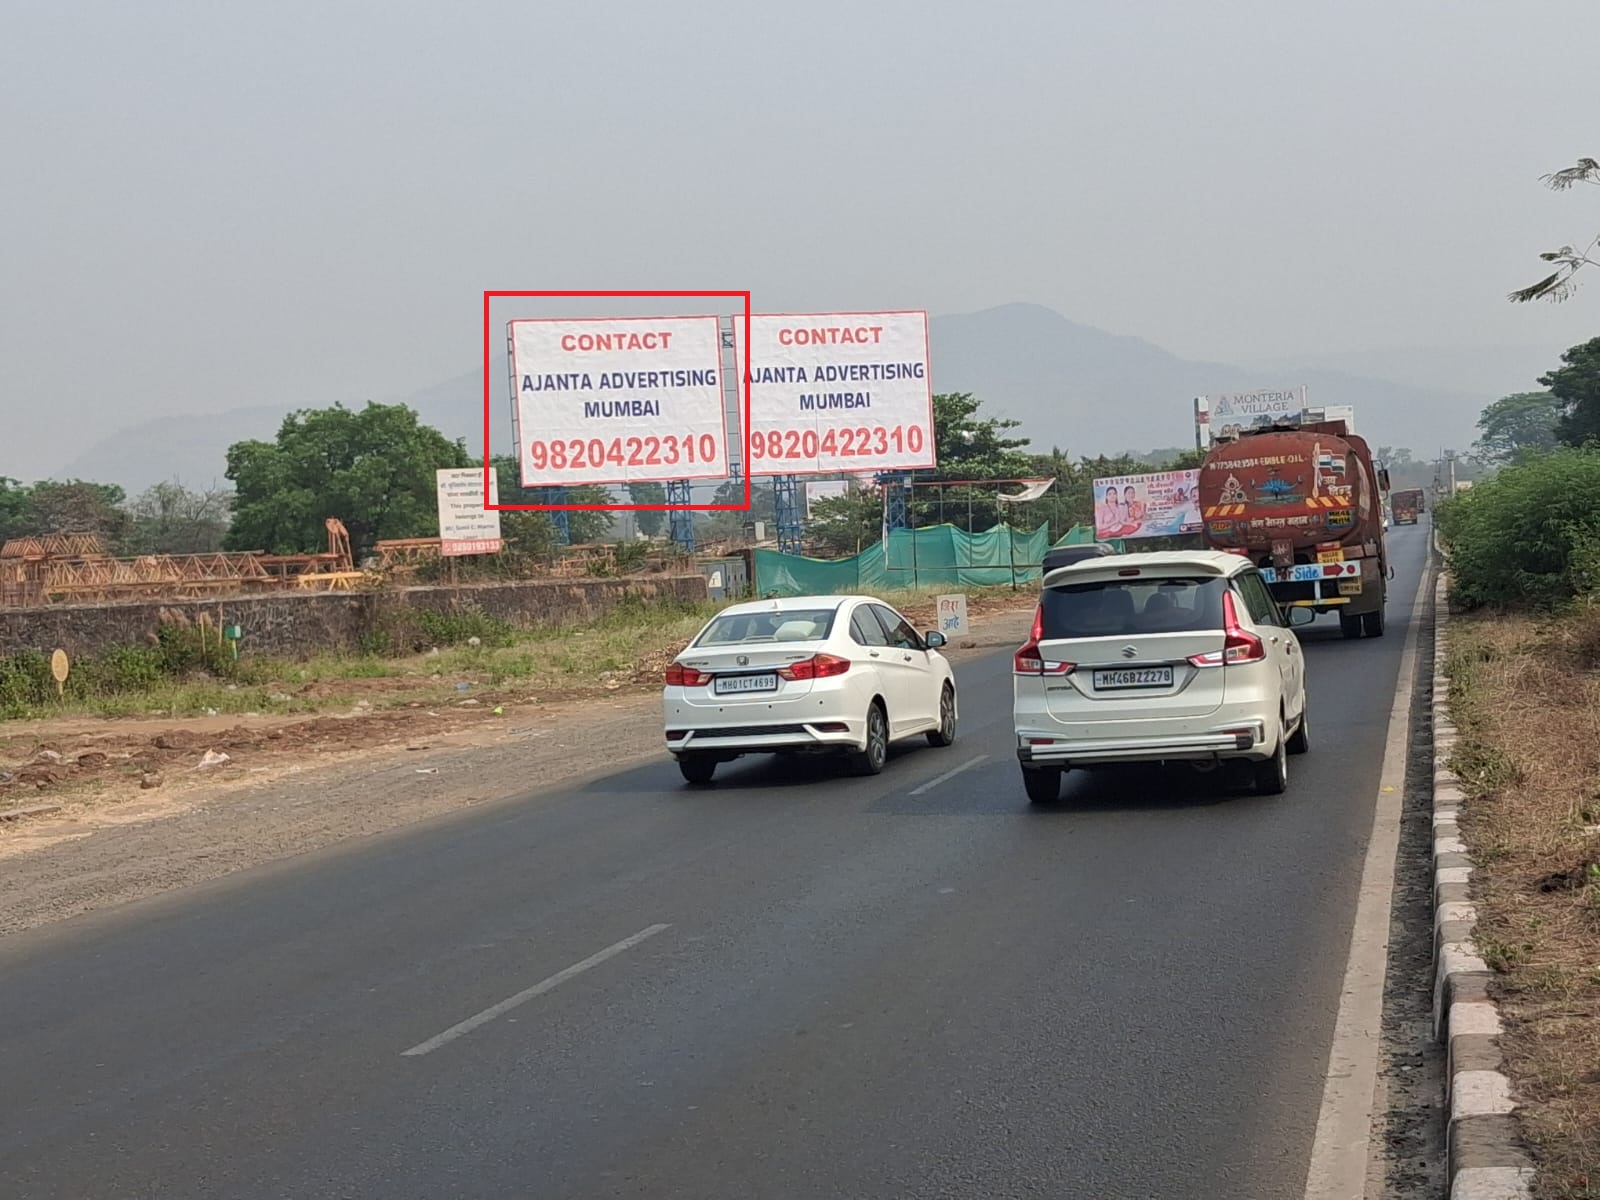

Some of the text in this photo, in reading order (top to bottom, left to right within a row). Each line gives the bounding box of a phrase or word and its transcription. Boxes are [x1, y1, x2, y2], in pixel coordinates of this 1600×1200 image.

[561, 332, 672, 351] CONTACT
[779, 326, 883, 346] CONTACT
[522, 369, 717, 392] AJANTA ADVERTISING
[814, 362, 924, 382] ADVERTISING
[800, 392, 871, 410] MUMBAI
[1233, 391, 1294, 405] MONTERIA
[584, 400, 660, 418] MUMBAI
[1241, 401, 1289, 414] VILLAGE
[750, 424, 923, 460] 9820422310
[531, 433, 716, 471] 9820422310
[1287, 453, 1304, 463] OIL
[1294, 566, 1319, 581] Side
